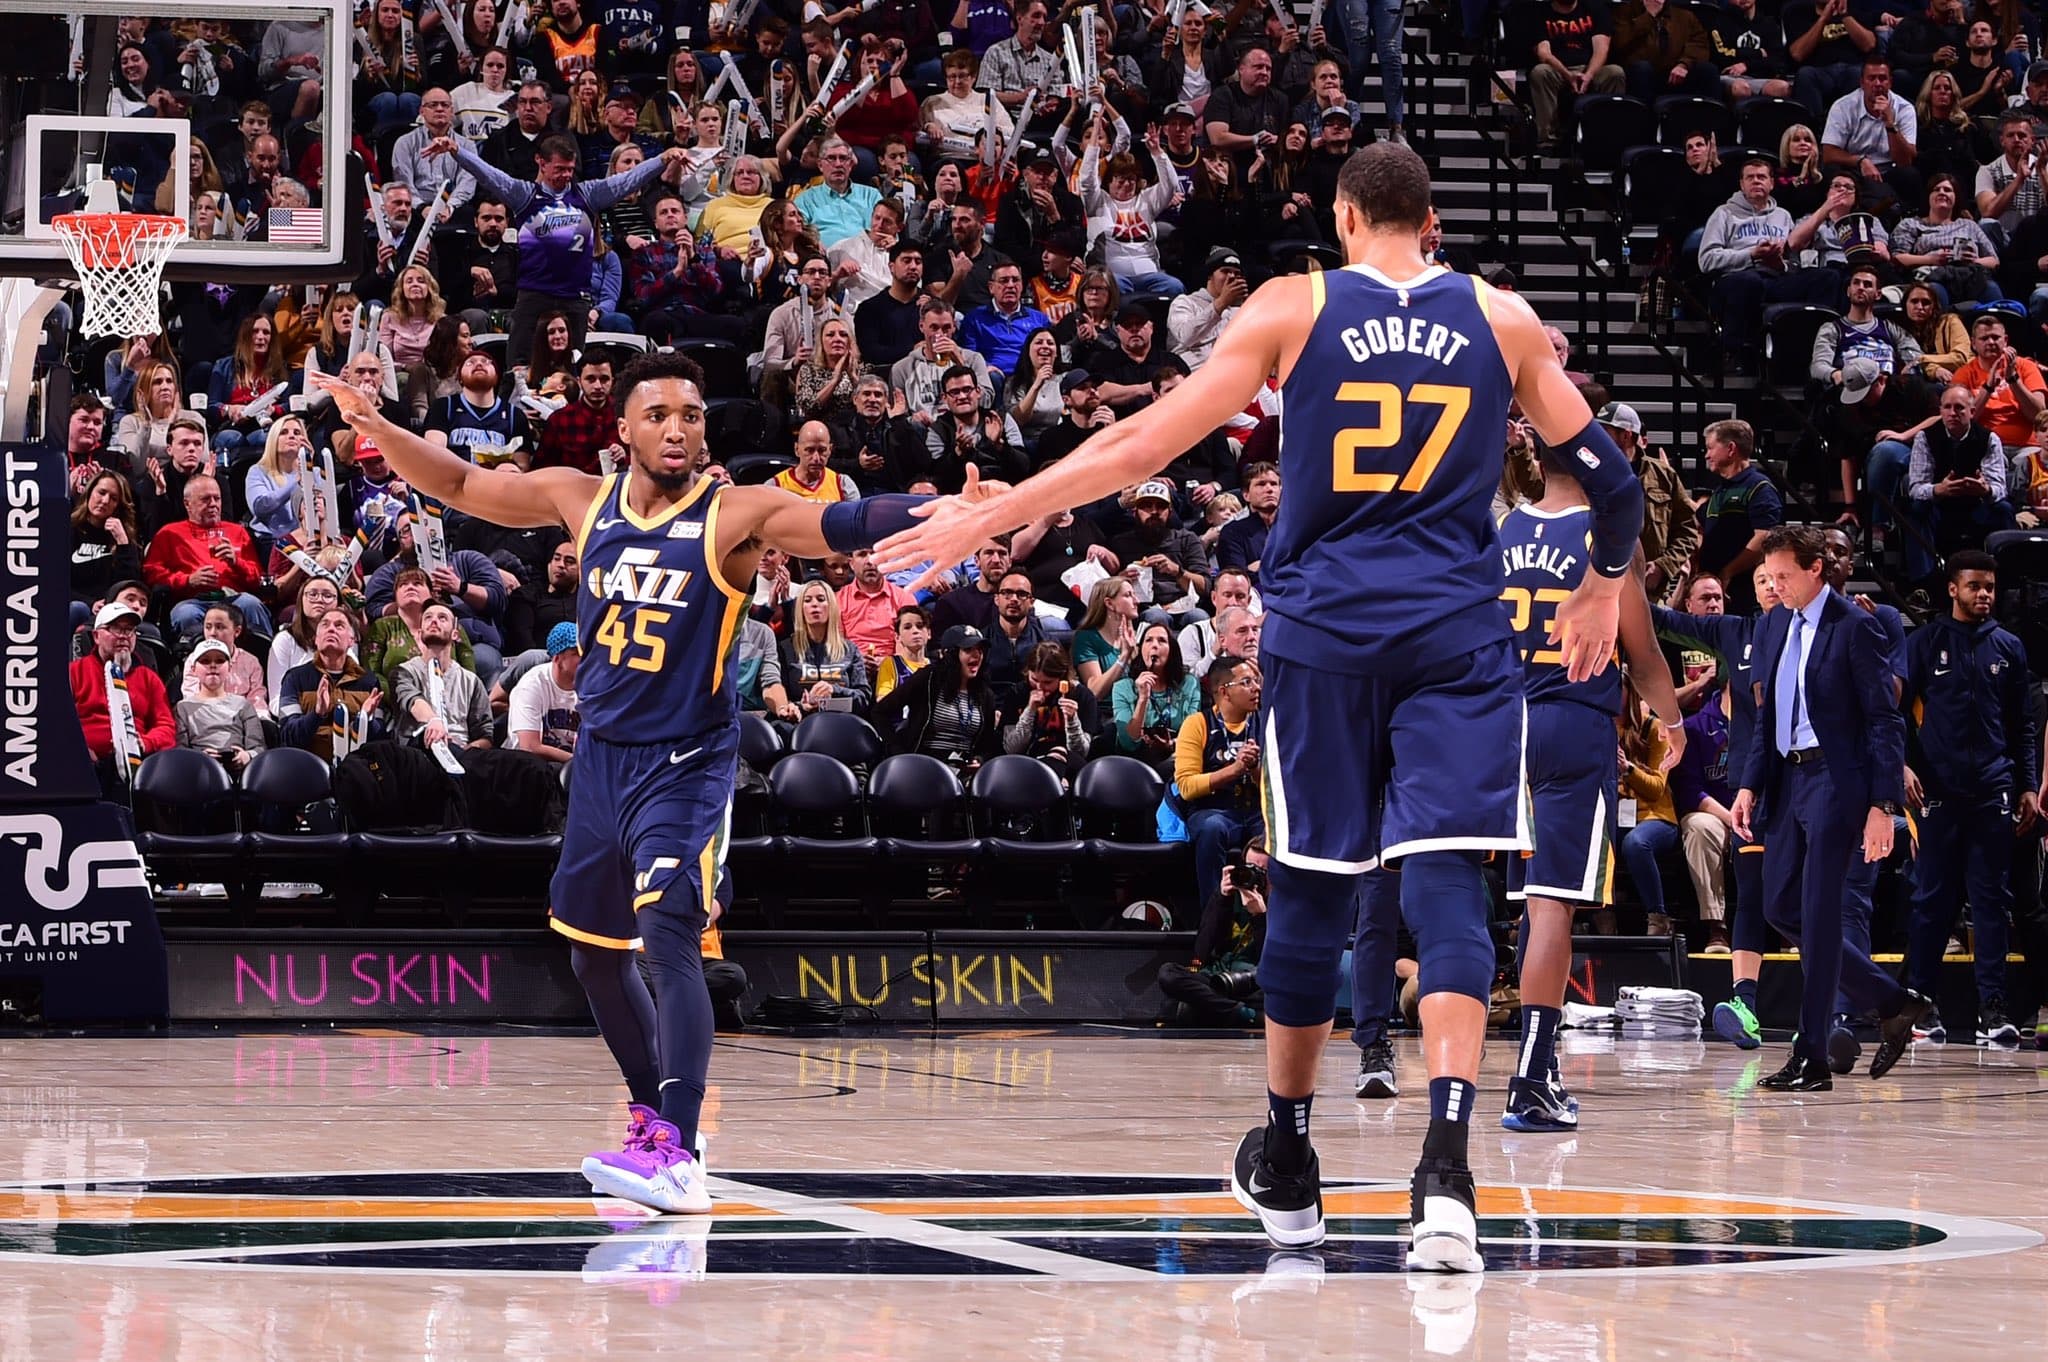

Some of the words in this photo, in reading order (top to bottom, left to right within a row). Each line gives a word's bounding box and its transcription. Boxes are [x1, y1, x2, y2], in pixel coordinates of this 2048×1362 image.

[605, 8, 653, 25] UTAH
[570, 234, 585, 252] 2
[1340, 316, 1471, 366] GOBERT
[1333, 382, 1471, 492] 27
[5, 451, 40, 576] FIRST
[588, 547, 692, 608] JAZZ
[596, 605, 671, 672] 45
[5, 585, 39, 786] AMERICA
[24, 951, 78, 962] UNION
[42, 921, 132, 946] FIRST
[235, 953, 328, 1006] NU
[351, 953, 491, 1006] SKIN
[798, 952, 889, 1007] NU
[911, 953, 1054, 1007] SKIN
